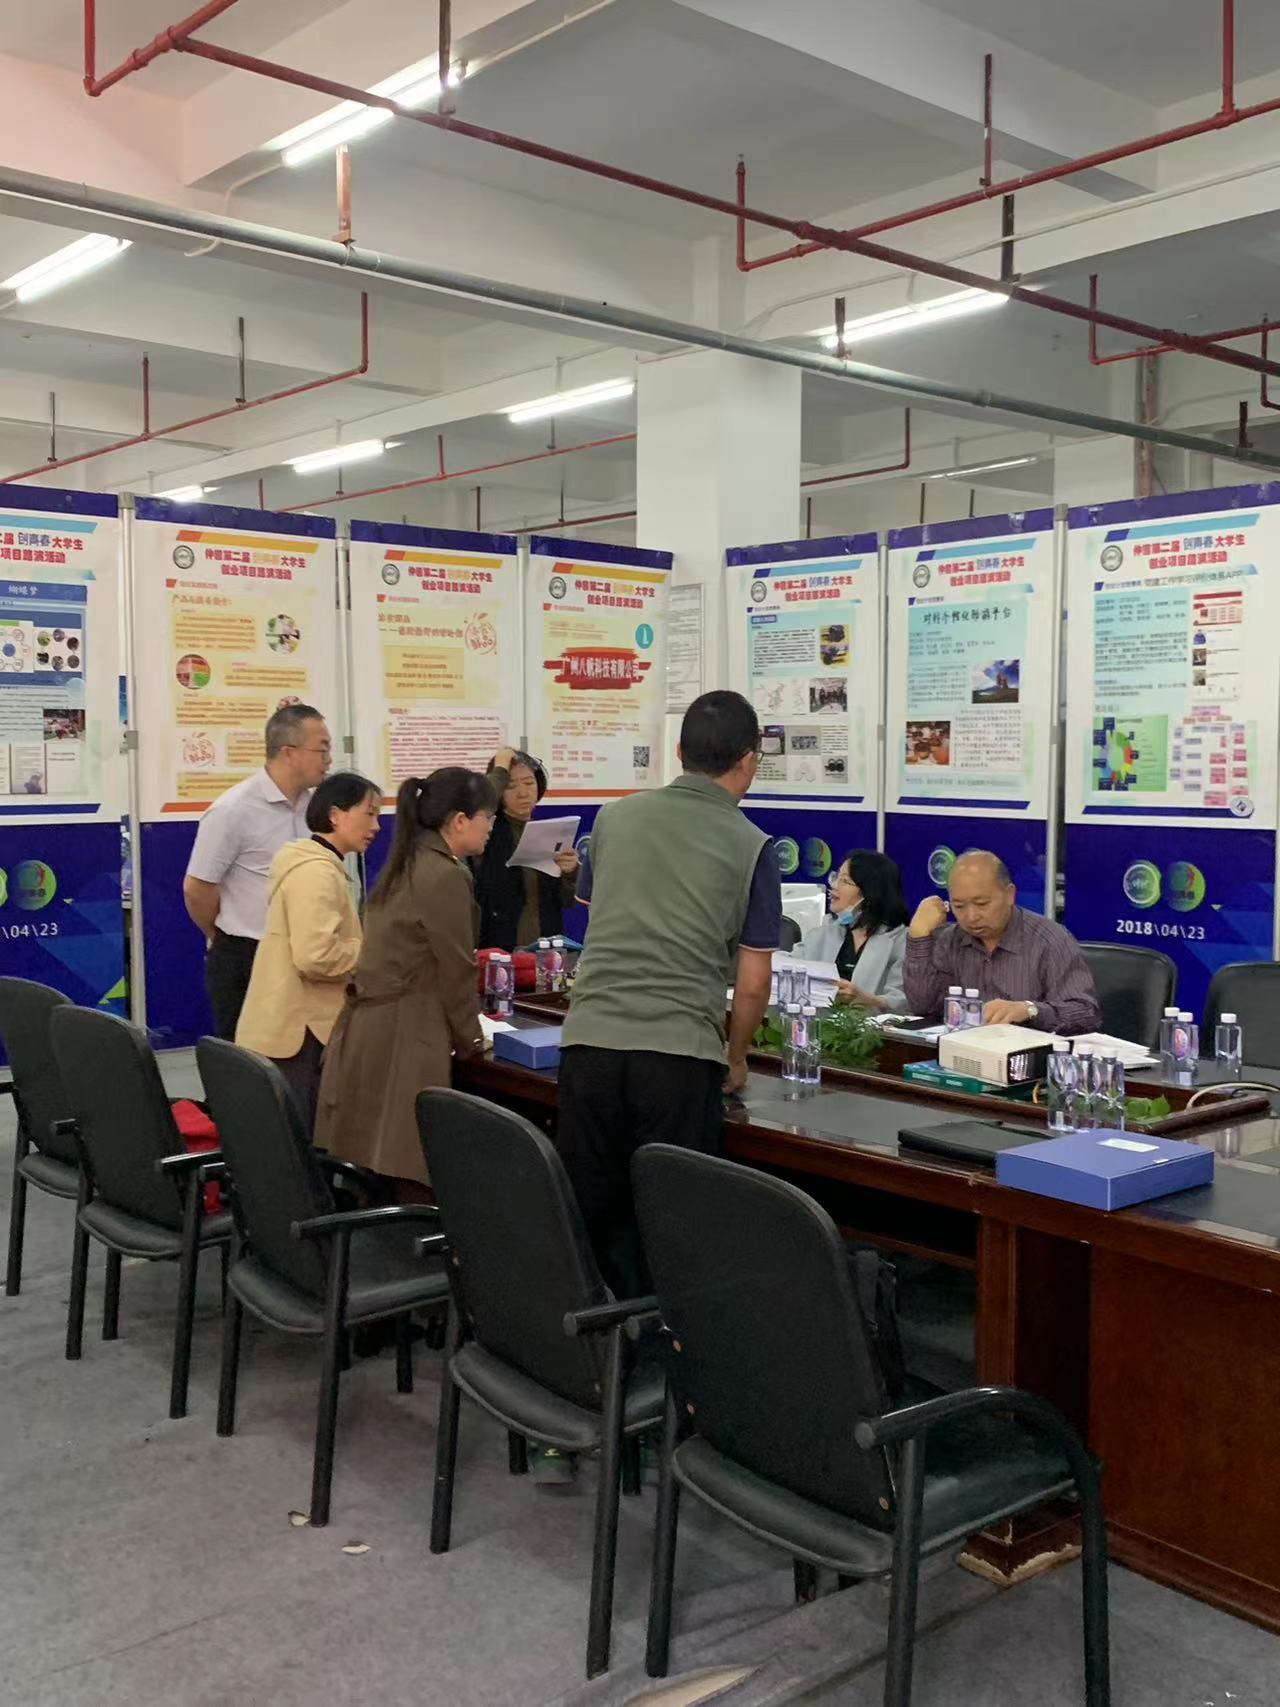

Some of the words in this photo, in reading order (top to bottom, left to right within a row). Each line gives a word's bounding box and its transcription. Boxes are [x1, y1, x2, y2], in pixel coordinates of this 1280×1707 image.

[0, 532, 14, 545] 届
[52, 537, 84, 551] 大学生
[1183, 535, 1214, 551] 创青春
[1214, 534, 1246, 549] 大学生
[0, 548, 66, 564] 项目路演活动
[280, 555, 306, 568] 大学生
[1000, 556, 1025, 569] 大学生
[1148, 551, 1228, 570] 创业项目路演活动
[471, 571, 493, 583] 大学生
[831, 575, 853, 586] 大学生
[634, 585, 656, 598] 大学生
[1116, 919, 1206, 940] 2018\04\23
